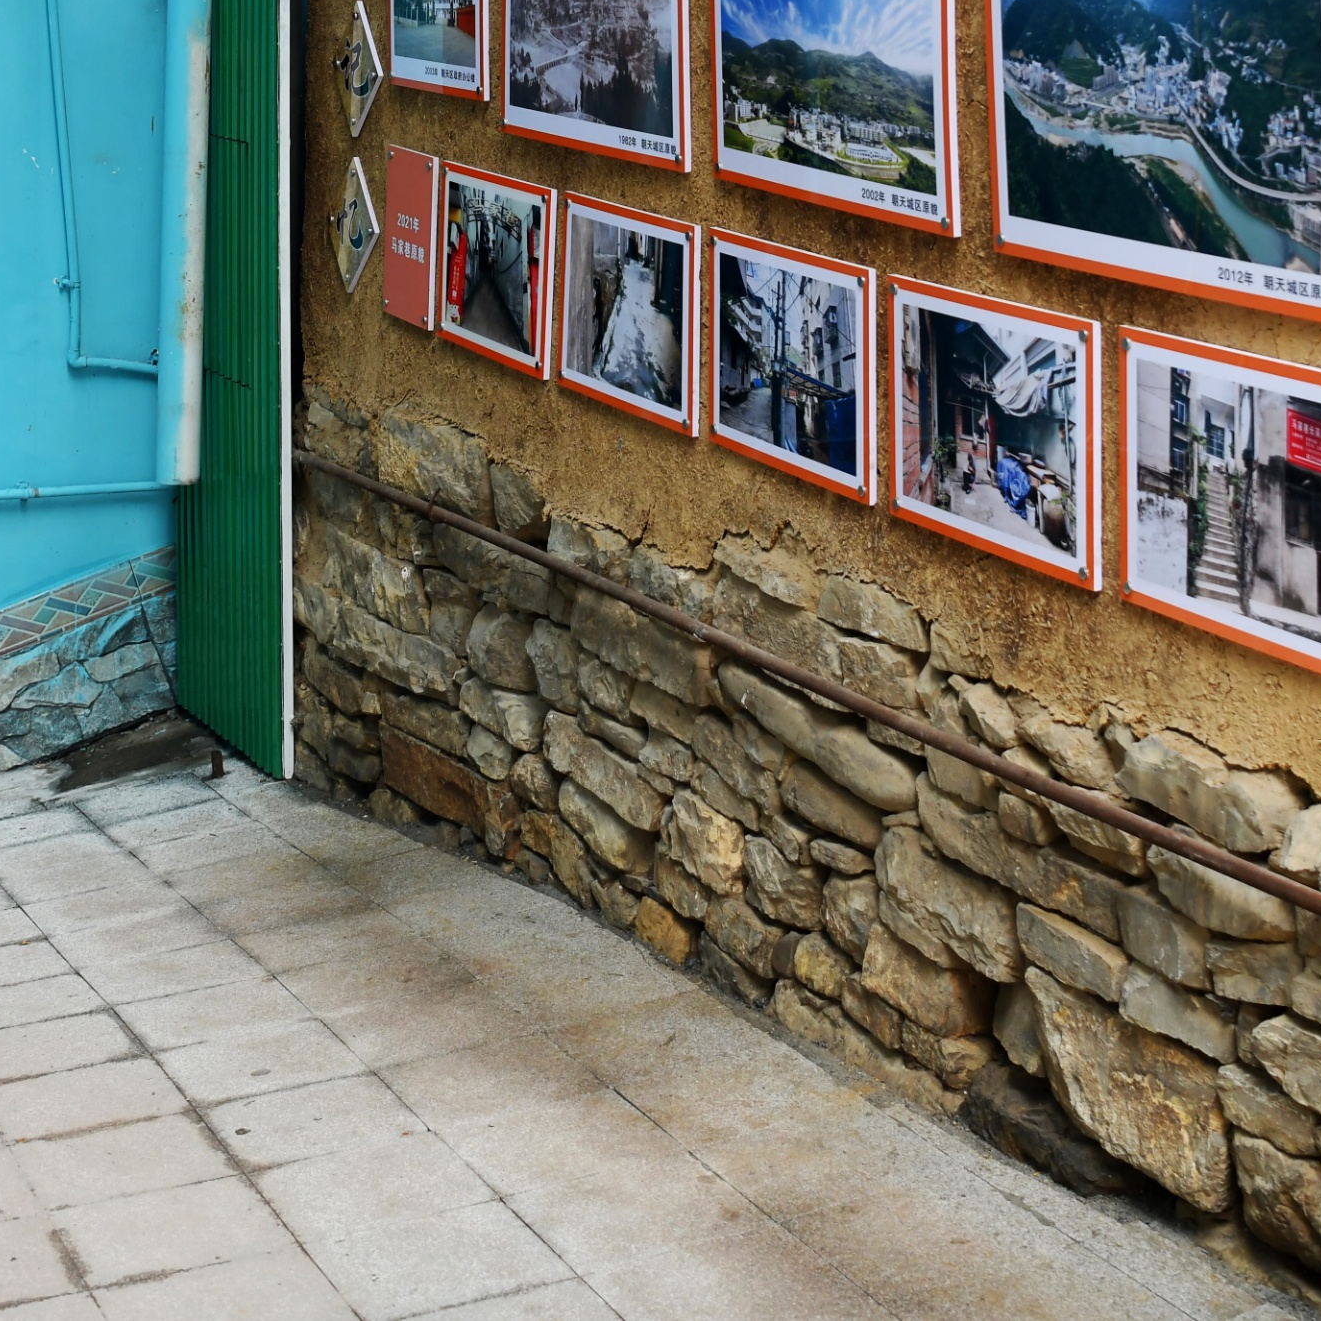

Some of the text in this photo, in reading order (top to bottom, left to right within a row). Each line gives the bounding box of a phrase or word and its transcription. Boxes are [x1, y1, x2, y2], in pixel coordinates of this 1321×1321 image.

[339, 37, 370, 99] 记
[619, 135, 677, 155] 1982年 朝天城区原貌
[861, 187, 938, 216] 2002年 朝天城区原貌
[336, 197, 365, 251] 忆
[397, 213, 420, 234] 2021年
[391, 236, 425, 264] 马家巷原貌
[1218, 267, 1253, 286] 2012年
